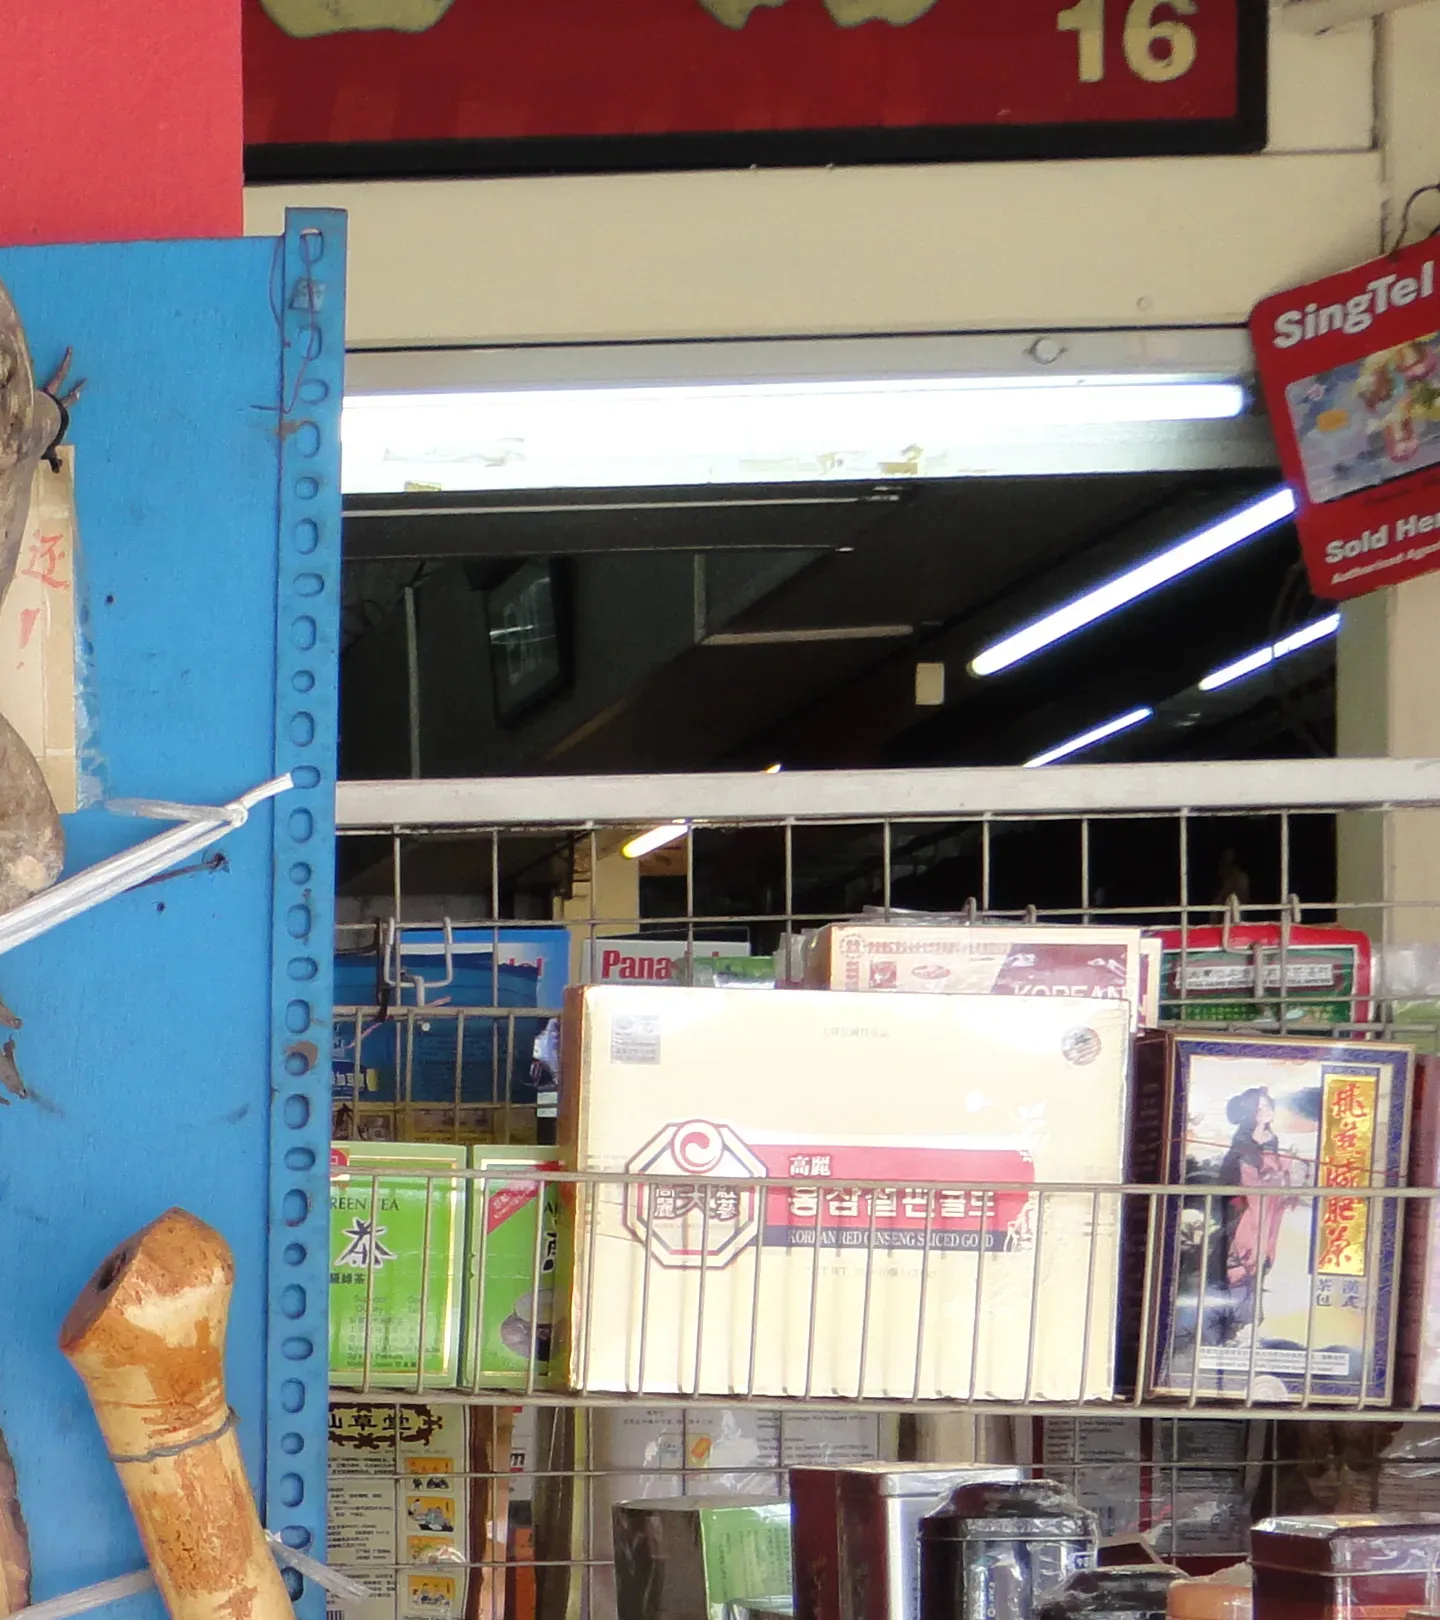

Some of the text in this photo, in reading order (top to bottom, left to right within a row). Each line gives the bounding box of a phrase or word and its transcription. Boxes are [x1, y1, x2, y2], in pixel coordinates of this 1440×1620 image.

[1057, 0, 1197, 83] 16
[1274, 260, 1434, 348] SingTel
[1325, 511, 1440, 563] Sold Her
[330, 1197, 399, 1211] REEN EA
[840, 1231, 861, 1245] RED
[961, 1234, 993, 1248] GOD
